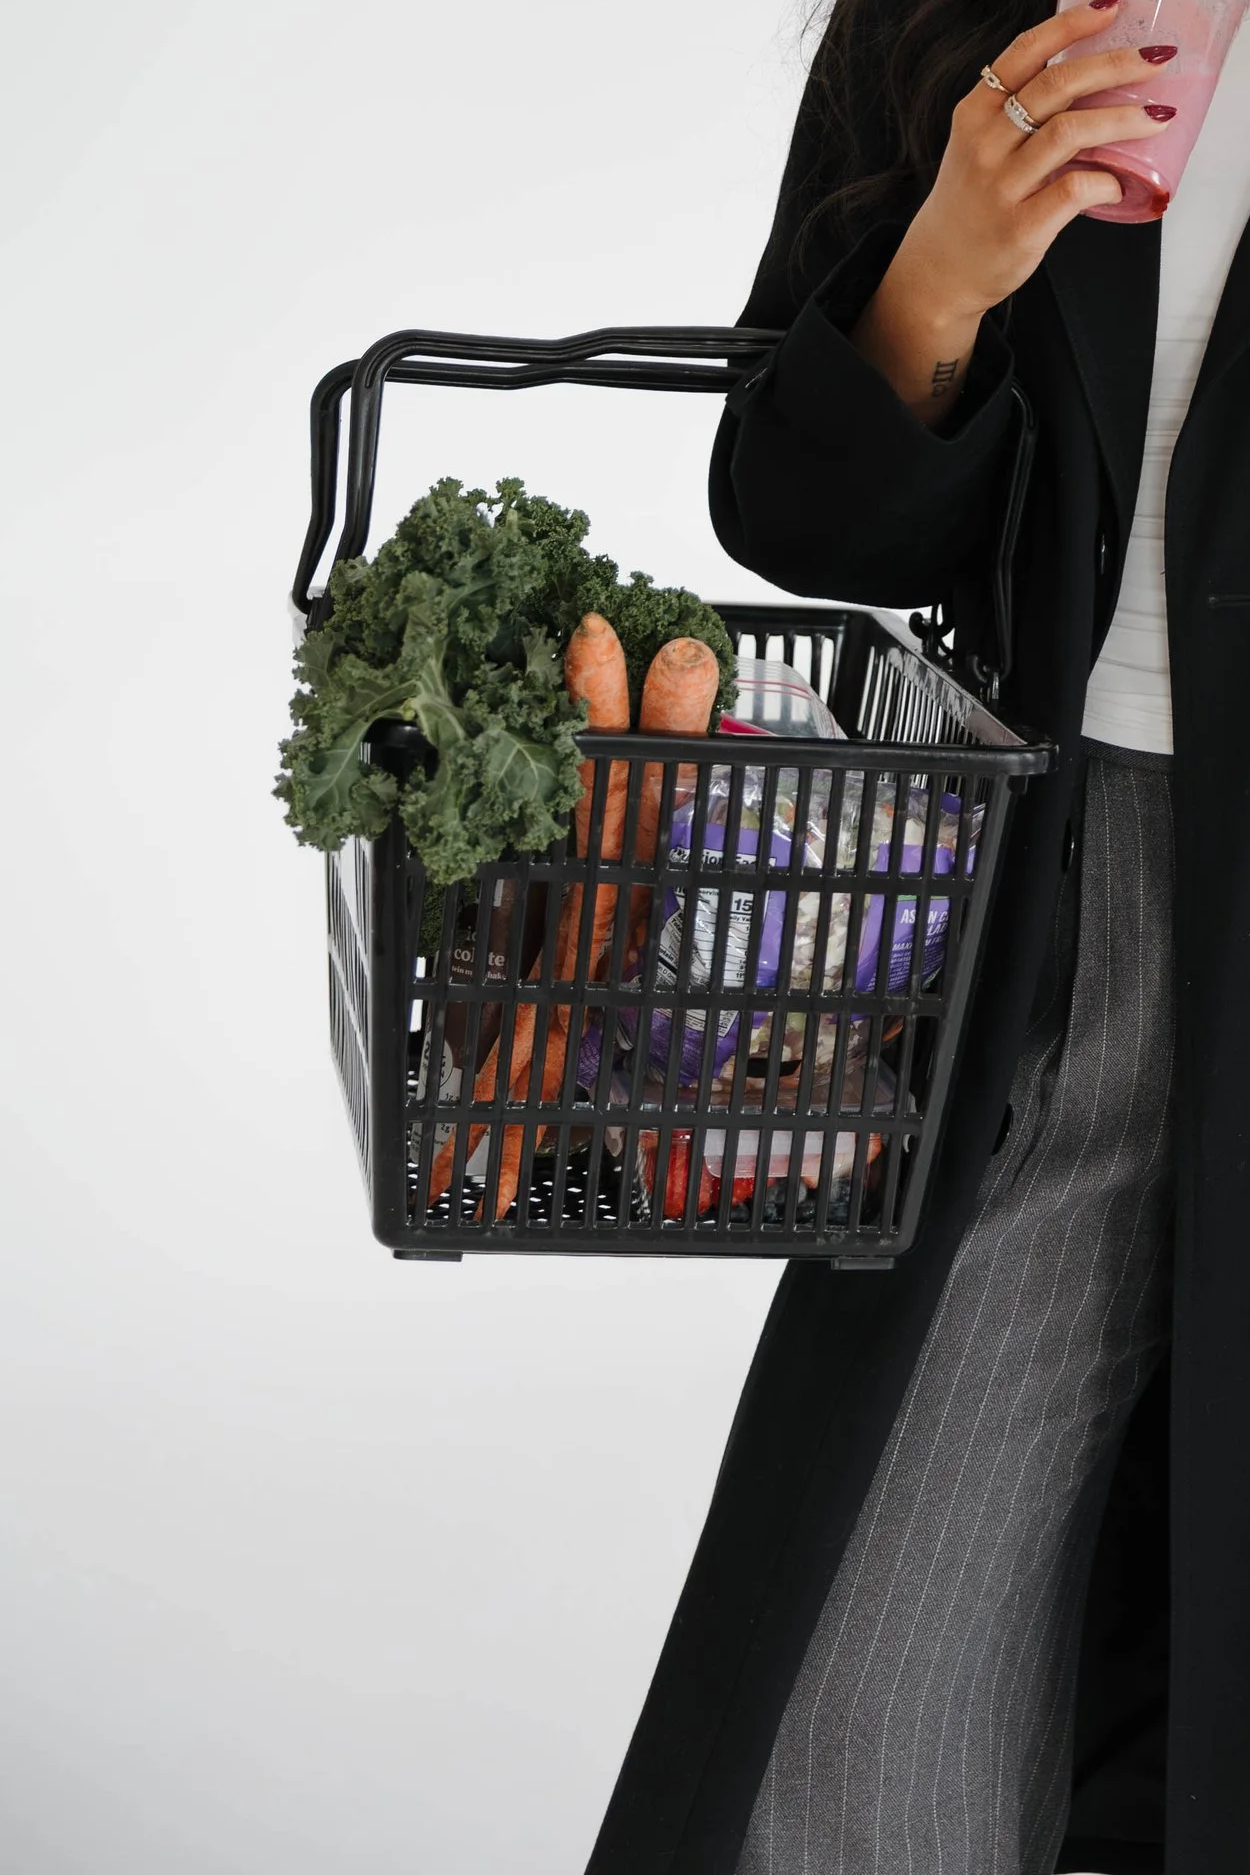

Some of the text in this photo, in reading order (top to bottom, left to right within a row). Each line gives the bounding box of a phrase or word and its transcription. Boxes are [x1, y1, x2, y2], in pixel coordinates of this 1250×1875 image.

[734, 898, 753, 912] 15
[900, 908, 938, 924] ASN
[454, 947, 505, 967] colte
